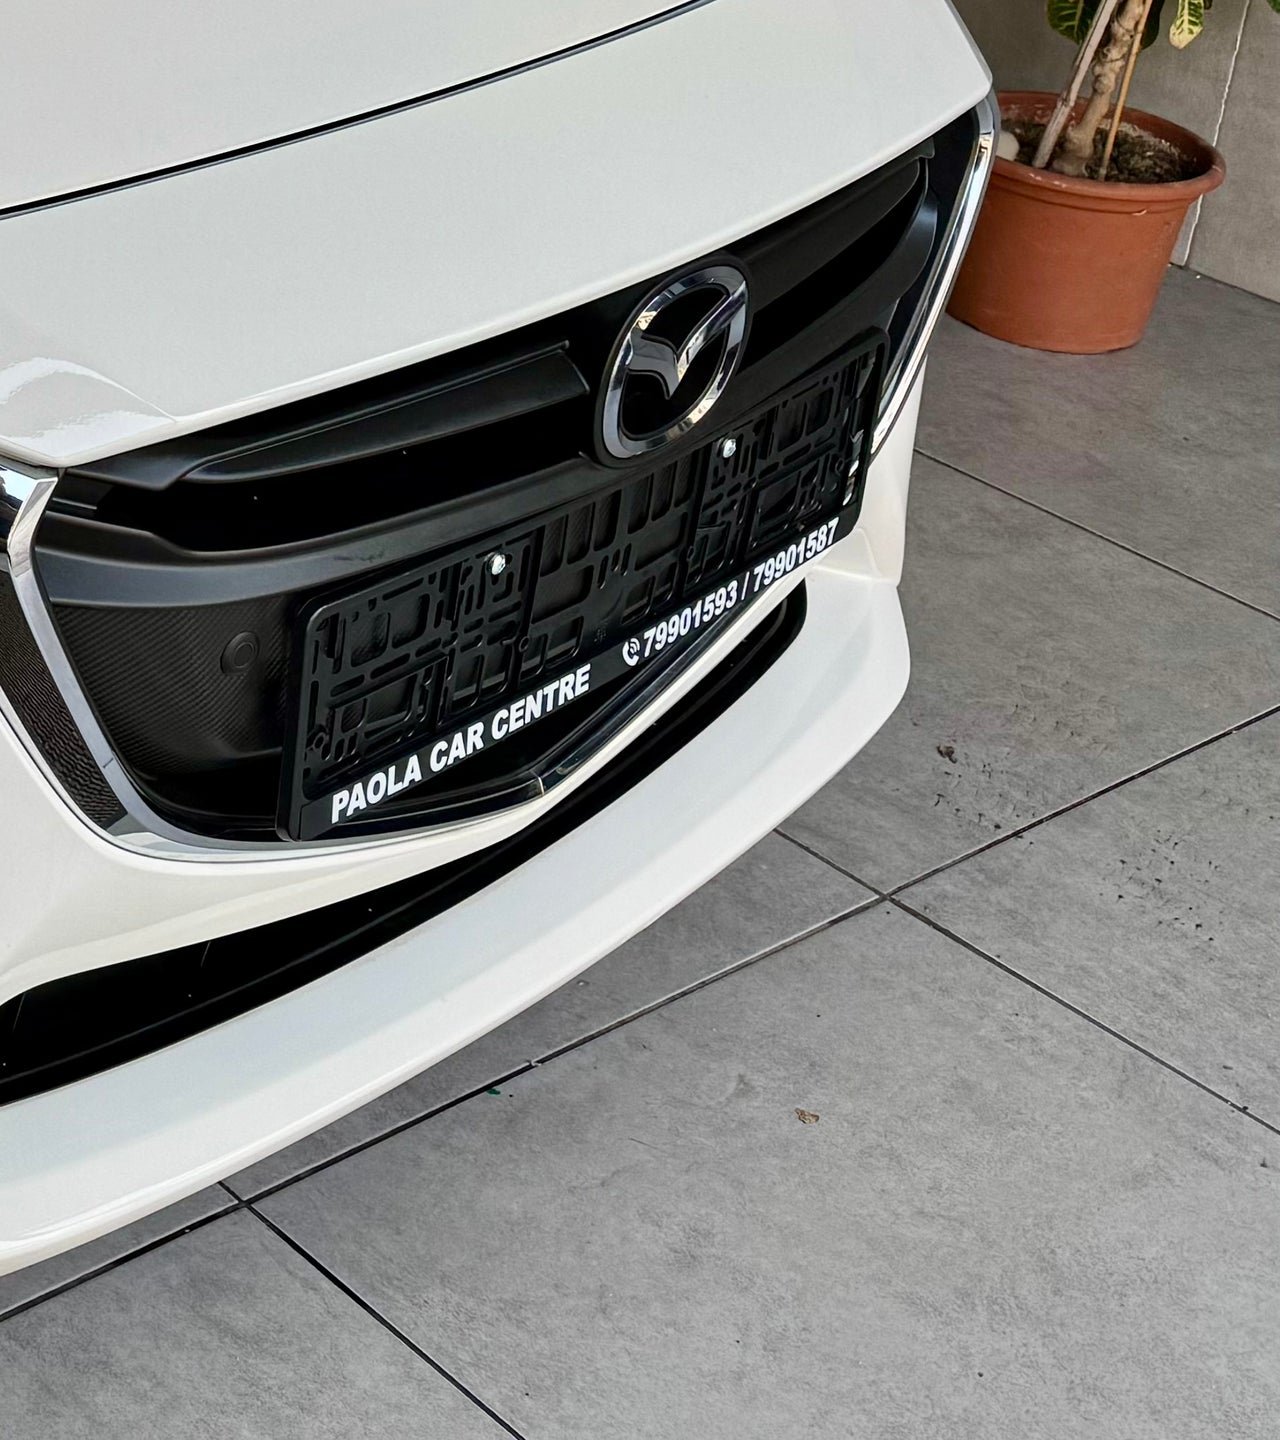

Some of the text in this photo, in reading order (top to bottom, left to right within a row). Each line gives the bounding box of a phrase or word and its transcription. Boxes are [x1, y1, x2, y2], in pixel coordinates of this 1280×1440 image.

[331, 516, 840, 824] PAOLA CAR CENTRE 79901593 / 79901587
